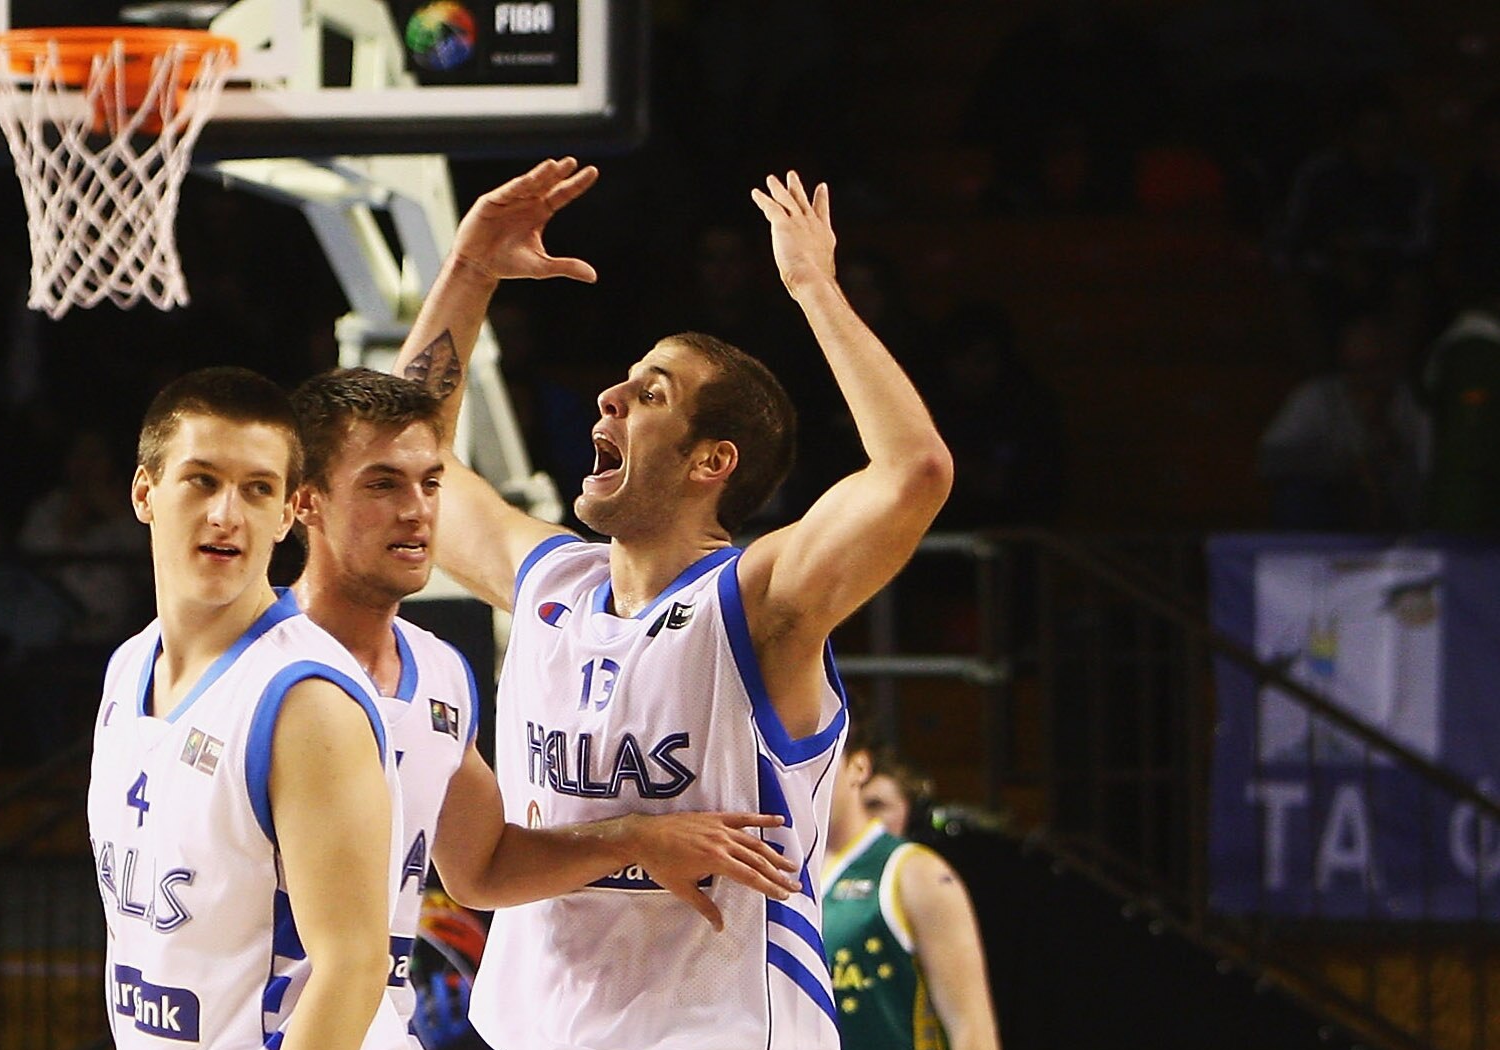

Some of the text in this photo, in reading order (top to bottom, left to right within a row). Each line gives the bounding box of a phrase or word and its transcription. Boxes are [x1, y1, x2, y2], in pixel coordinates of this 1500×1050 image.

[495, 2, 555, 33] FIBA
[577, 657, 621, 712] 13
[526, 720, 697, 800] HELLAS
[126, 771, 151, 829] 4
